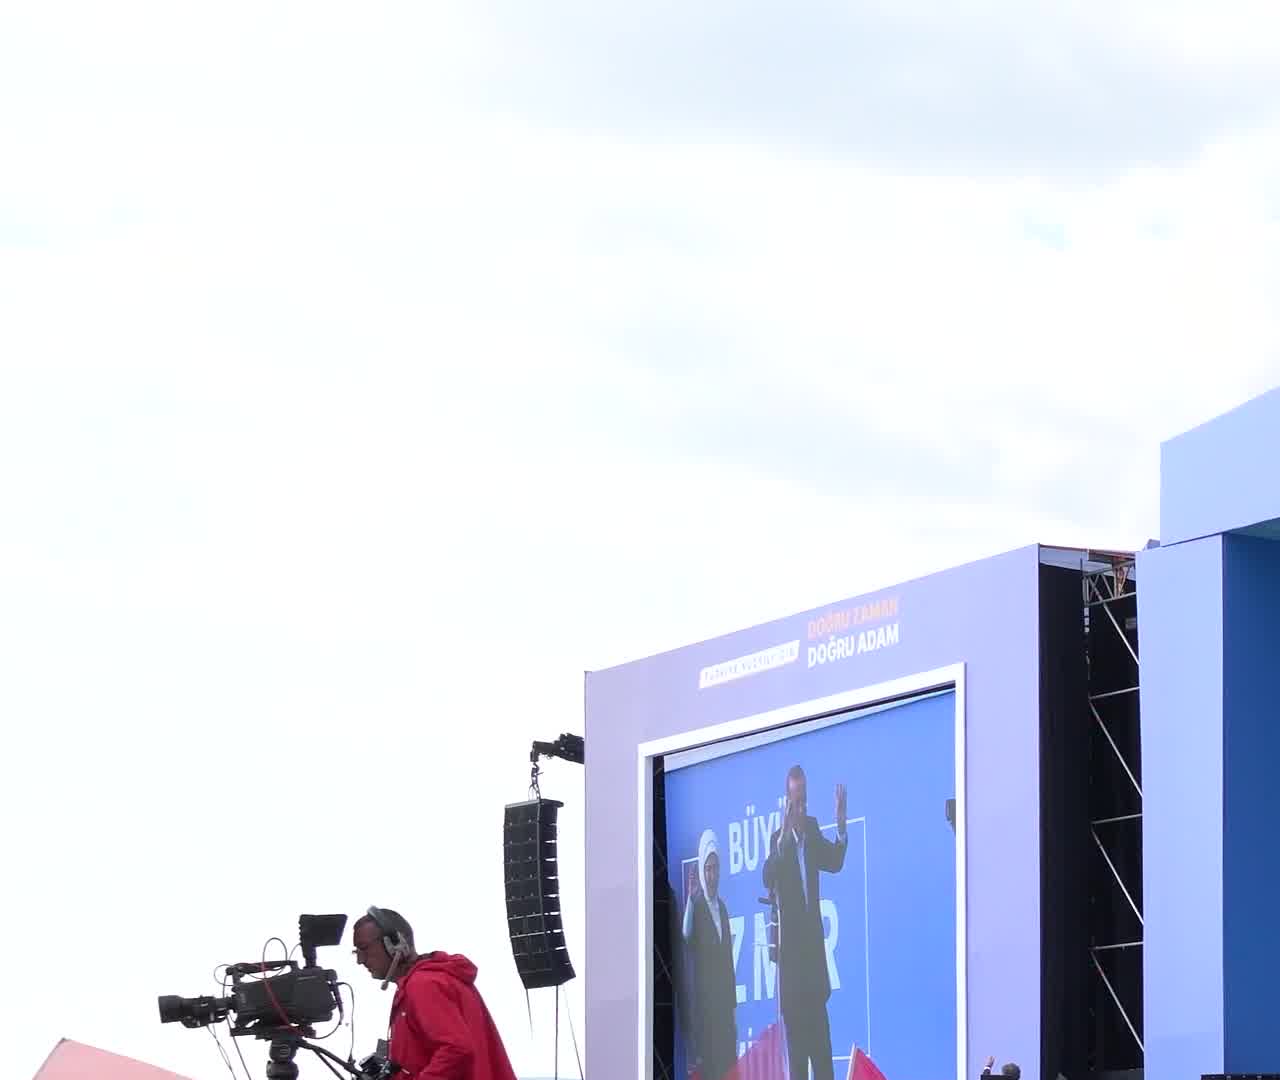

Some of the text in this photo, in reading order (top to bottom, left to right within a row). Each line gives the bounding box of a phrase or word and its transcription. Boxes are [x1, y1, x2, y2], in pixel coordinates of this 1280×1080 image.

[808, 635, 855, 668] DOĞRU
[857, 623, 899, 654] ADAM
[728, 796, 789, 874] BÜY
